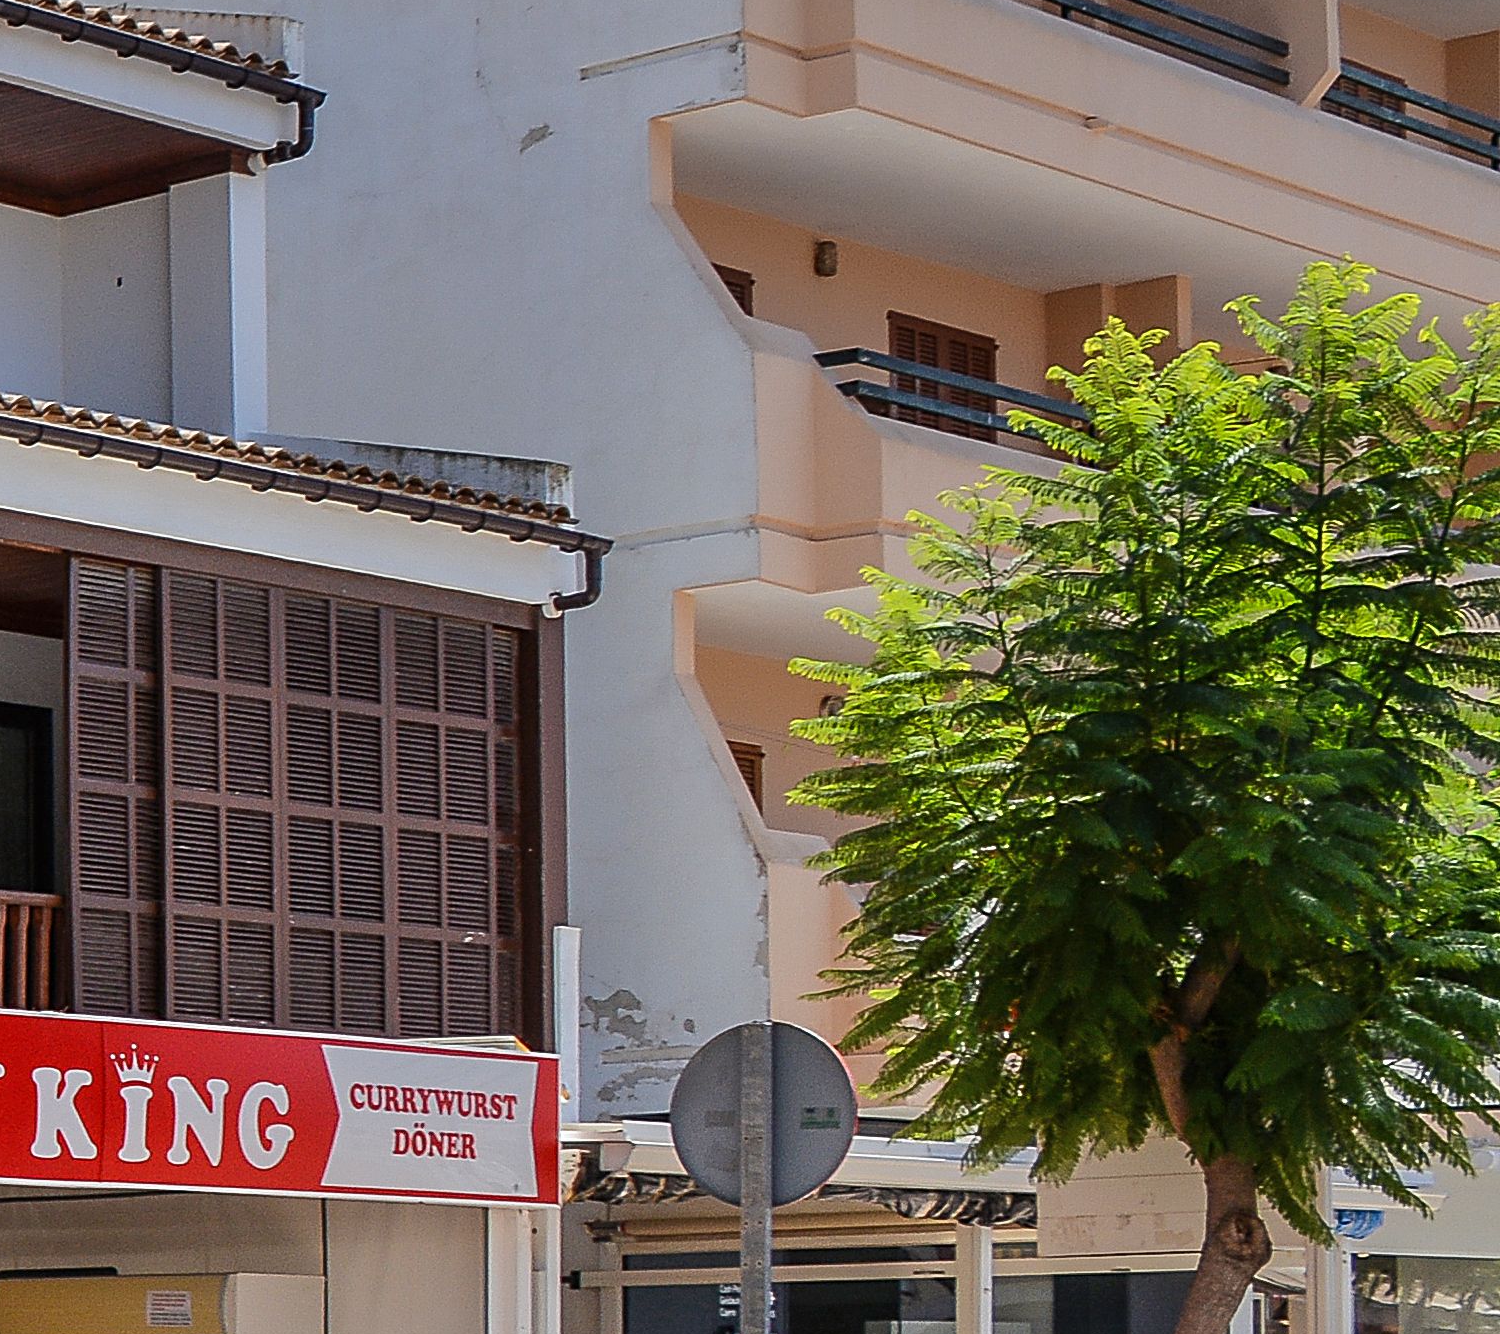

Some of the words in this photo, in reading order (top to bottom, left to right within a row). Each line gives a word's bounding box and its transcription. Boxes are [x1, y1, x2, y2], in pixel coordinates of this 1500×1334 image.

[30, 1048, 295, 1169] KING
[349, 1083, 518, 1120] CURRYWURST
[392, 1122, 477, 1160] DÖNER
